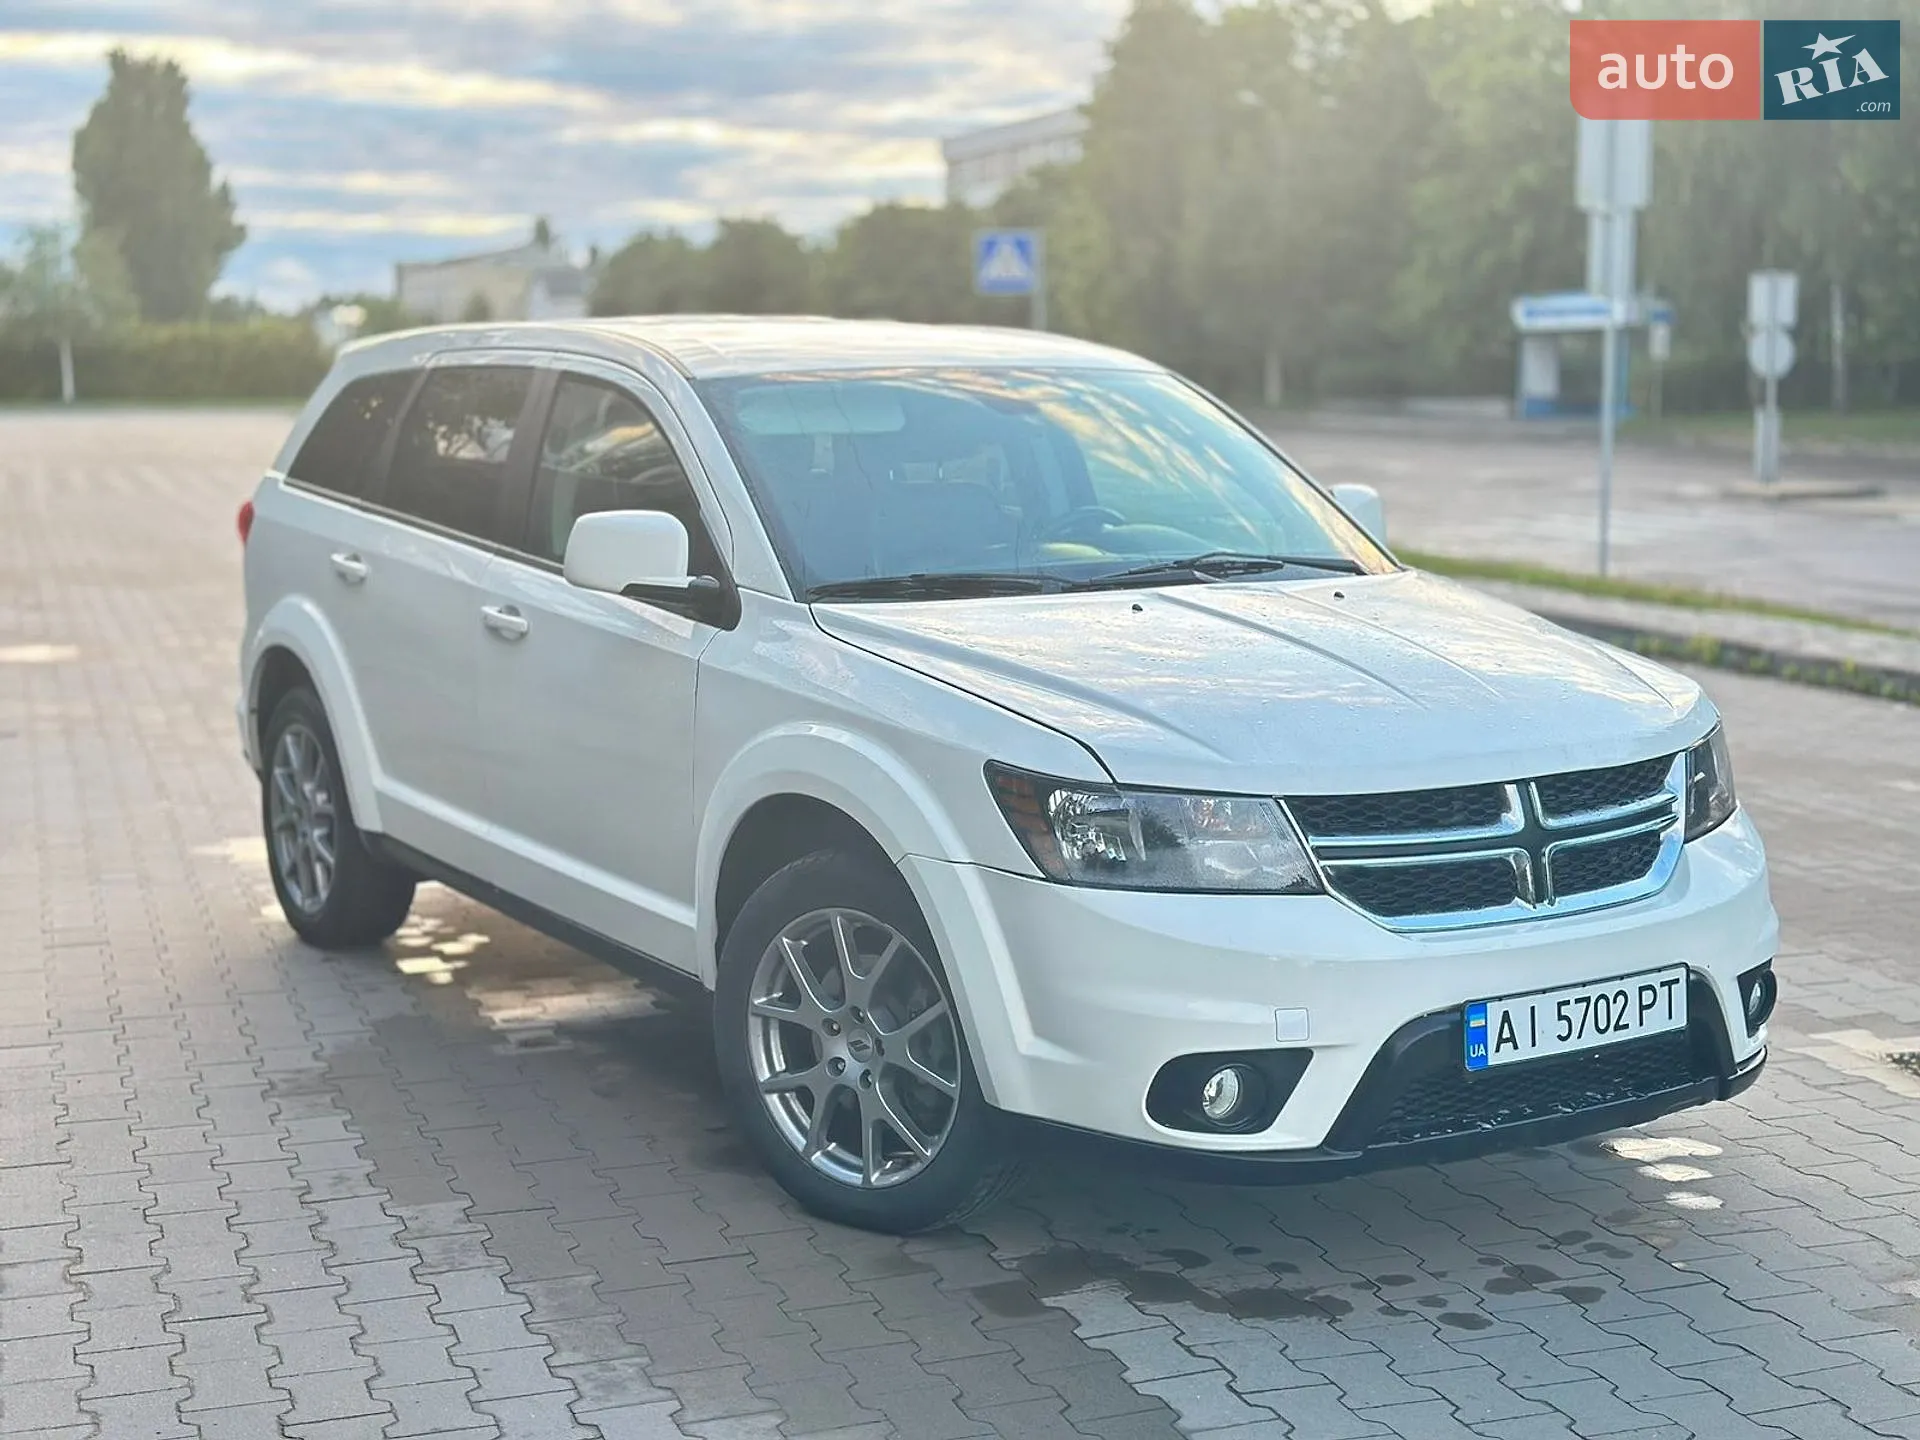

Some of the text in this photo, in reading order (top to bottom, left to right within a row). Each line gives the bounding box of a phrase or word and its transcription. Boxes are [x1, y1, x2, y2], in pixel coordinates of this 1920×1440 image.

[1494, 978, 1680, 1053] AI 5702 PT
[1470, 1044, 1487, 1058] UA
